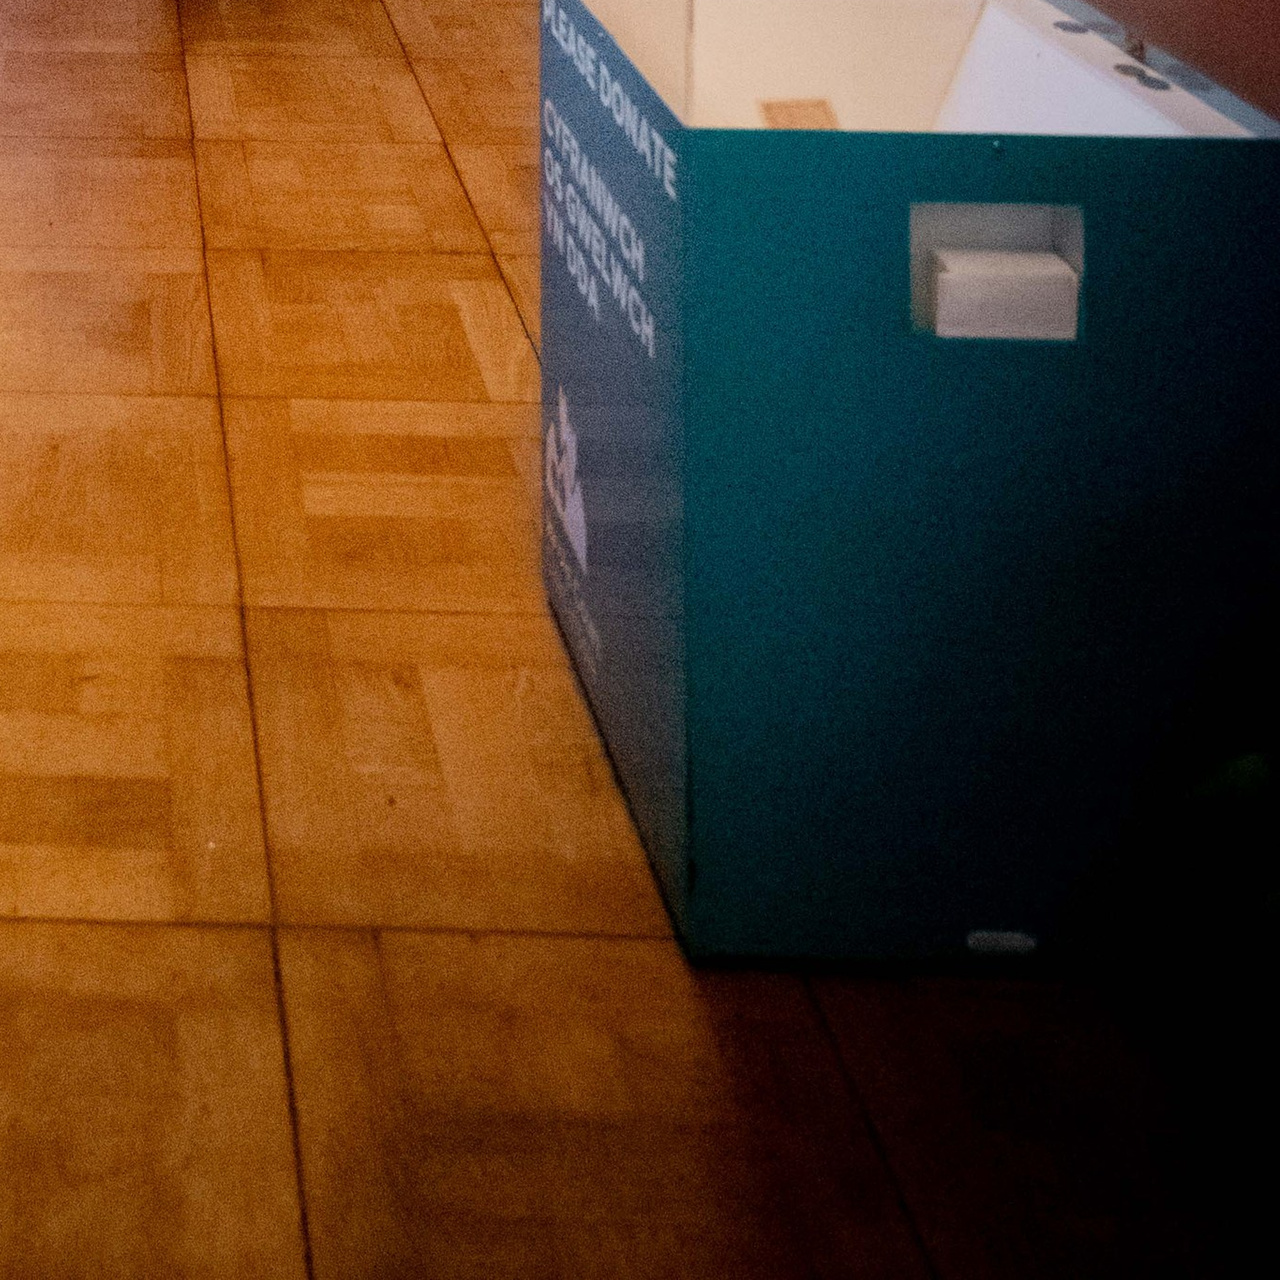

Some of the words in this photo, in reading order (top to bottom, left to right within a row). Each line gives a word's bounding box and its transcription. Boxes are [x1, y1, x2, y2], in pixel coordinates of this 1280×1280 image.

[544, 99, 645, 283] CYFRANWCH
[598, 61, 678, 201] DONATE
[544, 147, 563, 203] OS
[566, 183, 656, 359] GWELWCH
[566, 233, 600, 322] DDA
